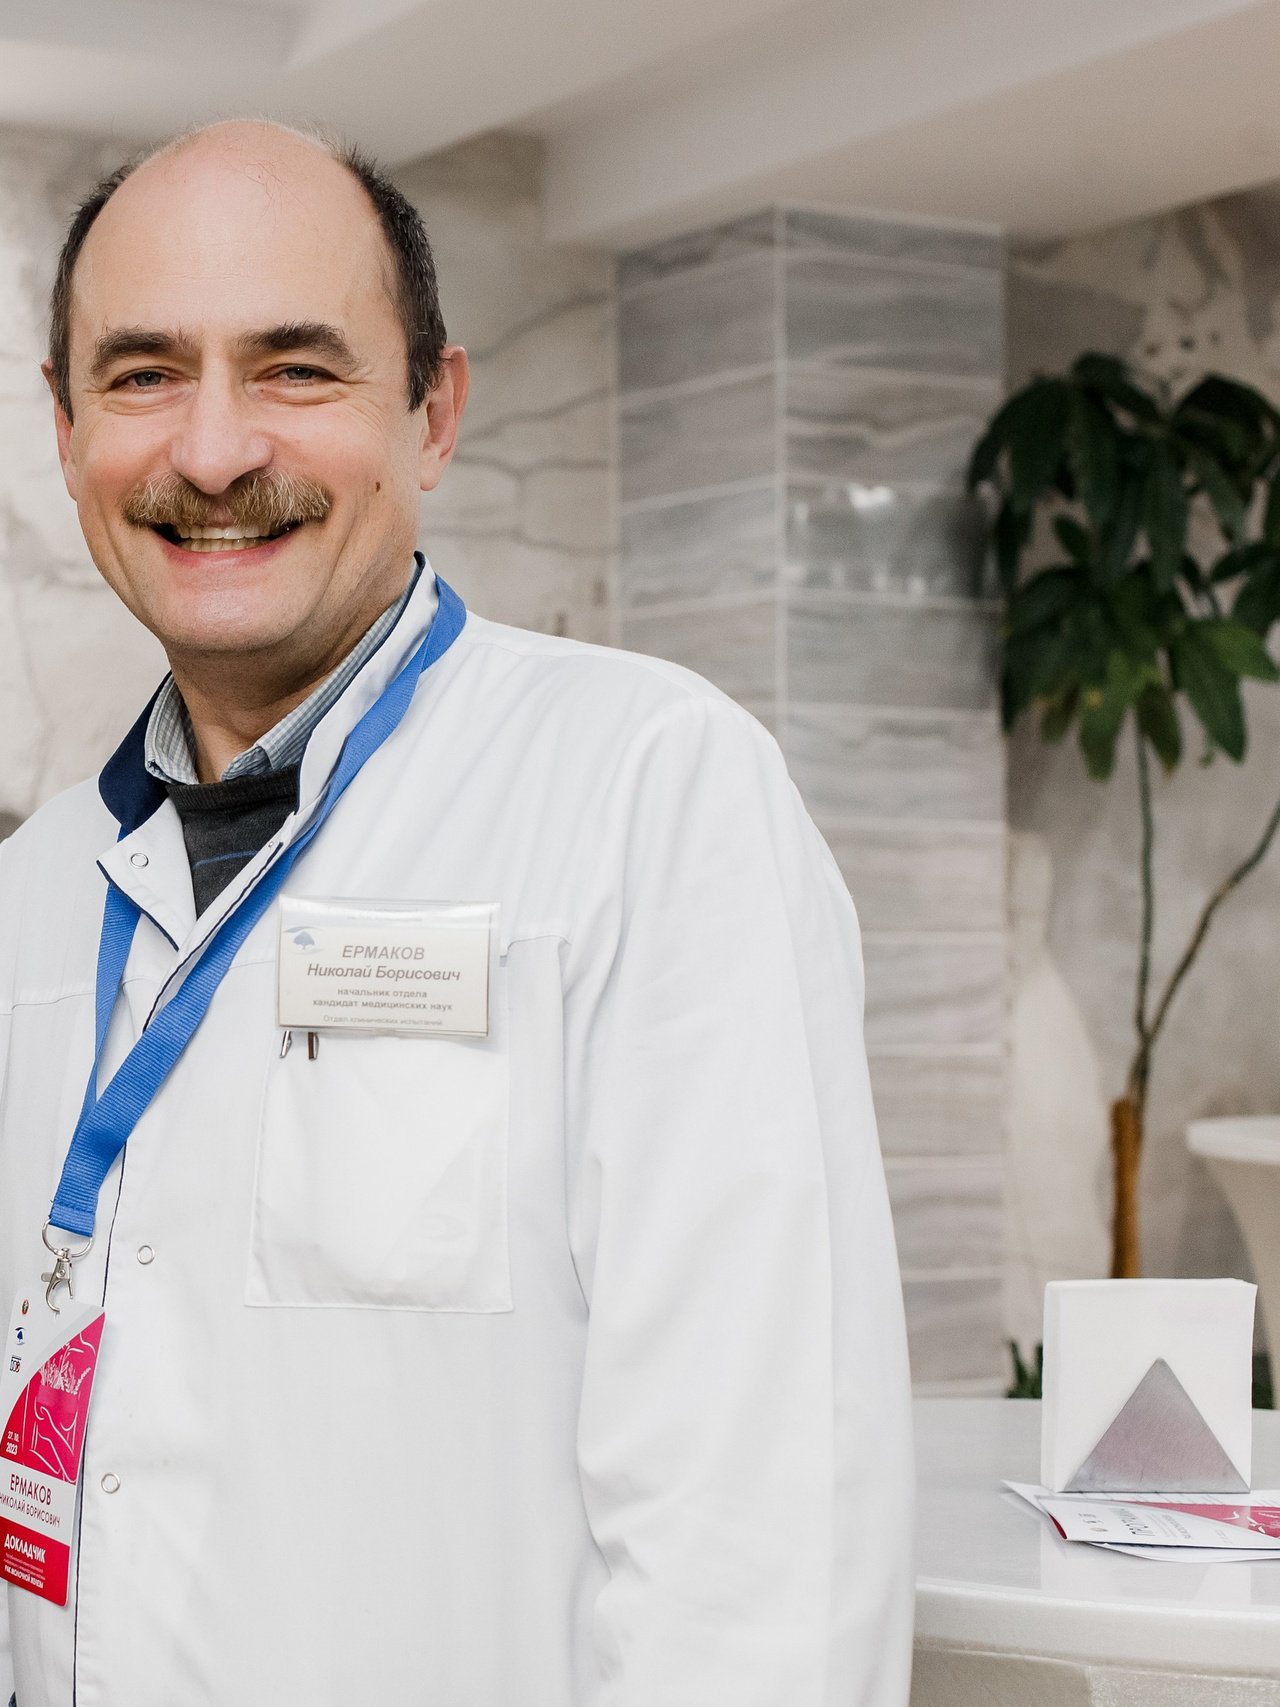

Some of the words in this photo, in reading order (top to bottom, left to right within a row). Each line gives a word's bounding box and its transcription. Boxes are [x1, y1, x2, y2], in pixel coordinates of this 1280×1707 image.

[341, 945, 425, 960] ЕРМАКОВ
[307, 963, 372, 978] Николай
[375, 965, 461, 982] Борисович
[337, 988, 390, 997] начальник
[393, 990, 428, 999] отдела
[313, 999, 359, 1008] кандидат
[361, 1000, 427, 1010] медицинских
[430, 1003, 453, 1012] наук
[10, 1473, 52, 1506] ЕРМАКОВ
[26, 1503, 61, 1528] БОРИСОВИЧ
[4, 1533, 46, 1564] ДОКЛАДЧИК
